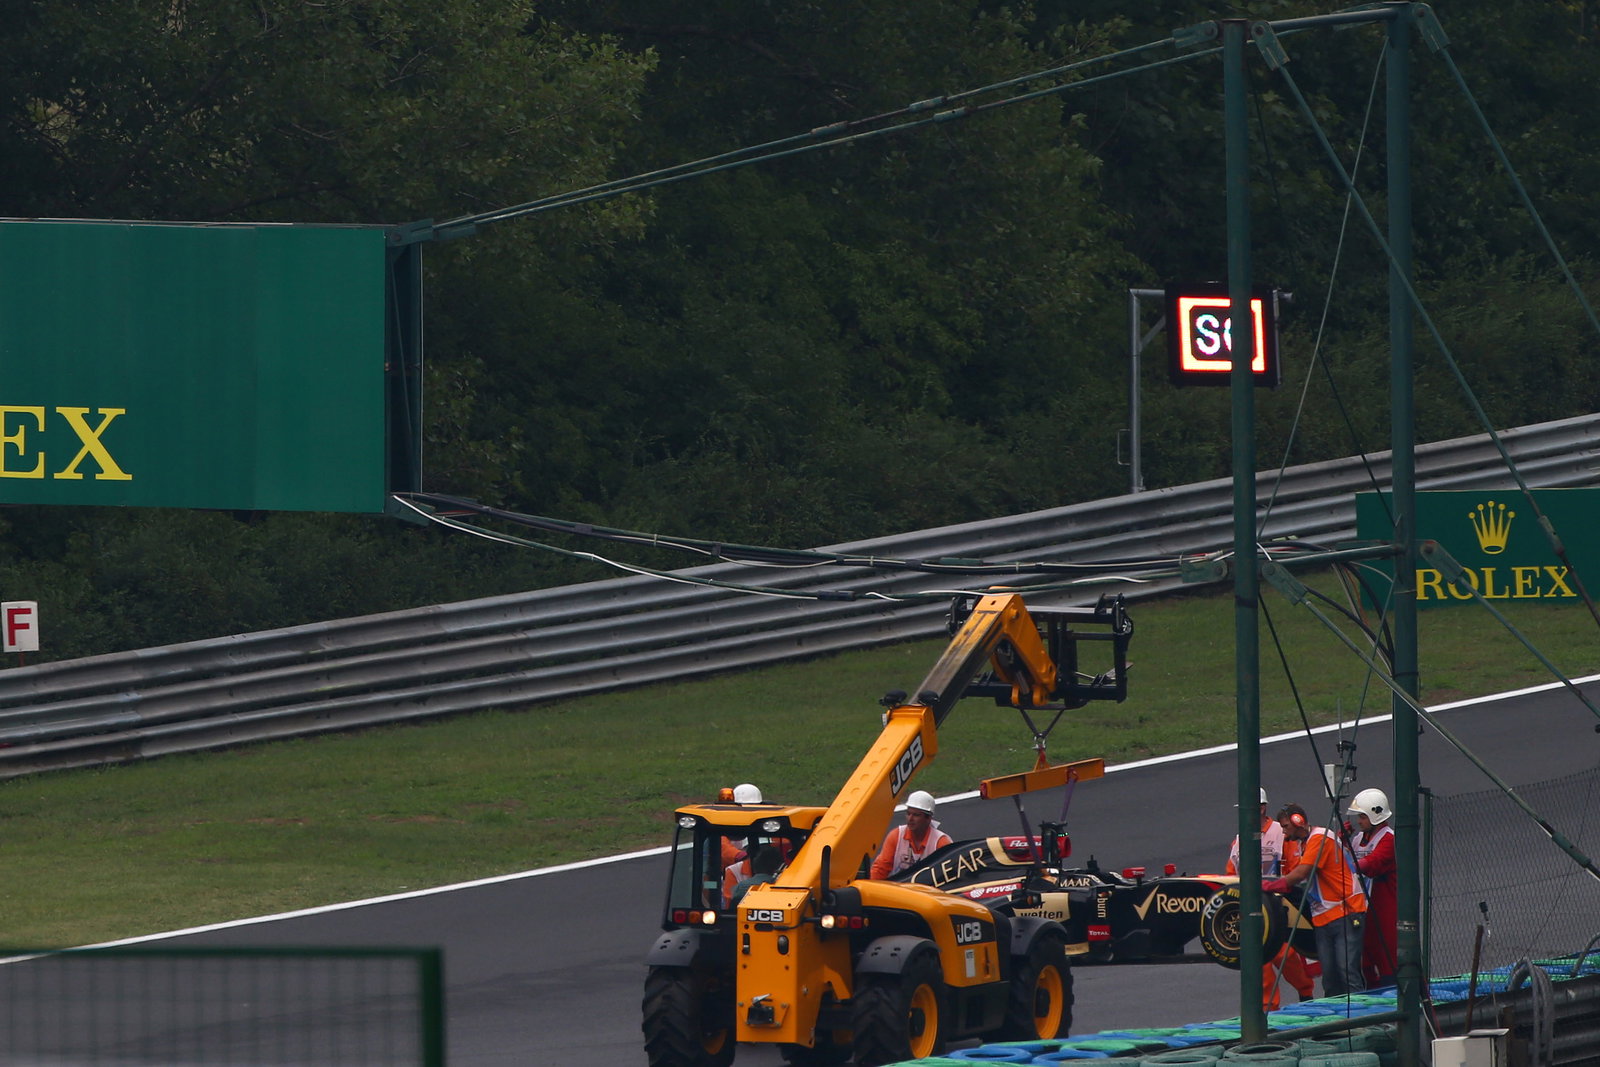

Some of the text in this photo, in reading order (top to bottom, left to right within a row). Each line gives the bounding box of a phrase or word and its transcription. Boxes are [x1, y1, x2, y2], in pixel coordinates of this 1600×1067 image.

[1196, 314, 1232, 355] S
[0, 405, 133, 481] EX
[1416, 565, 1577, 600] ROLEX
[7, 608, 32, 646] F
[892, 734, 925, 796] JCB
[910, 847, 988, 888] CLEAR
[985, 884, 1018, 895] PDVSA
[1097, 897, 1109, 918] burn
[747, 909, 784, 923] JCB
[956, 921, 982, 944] JCB
